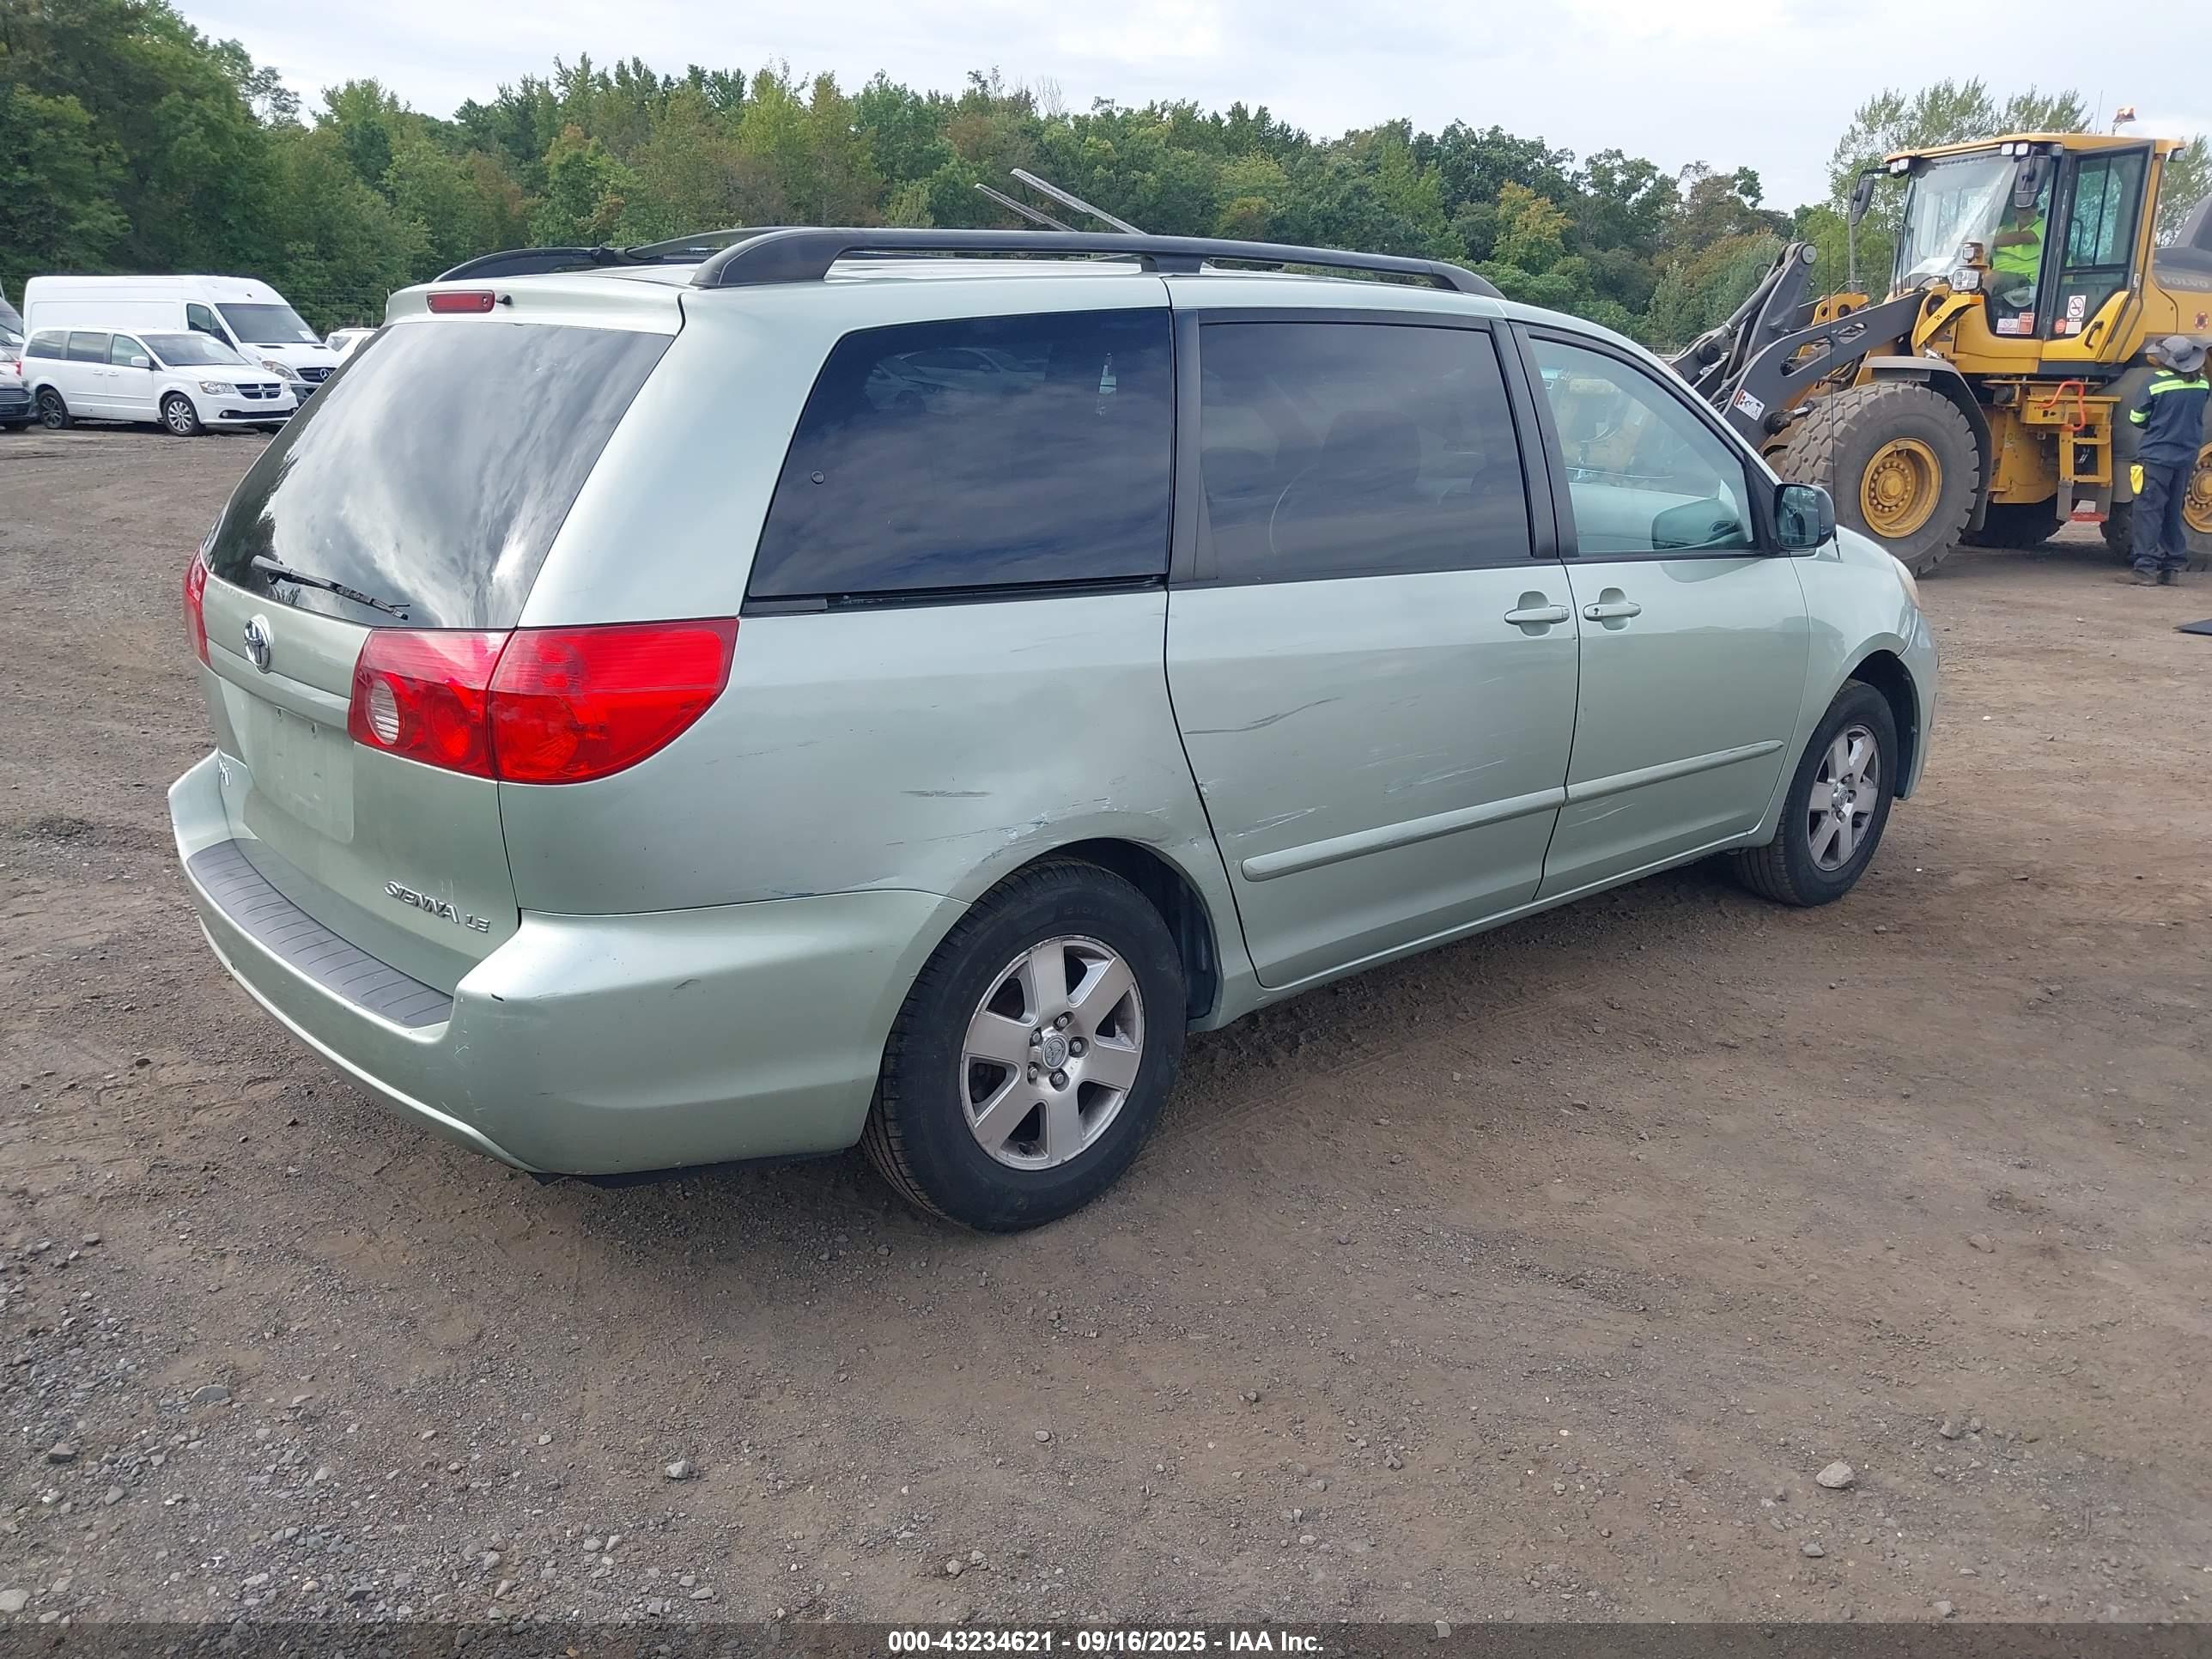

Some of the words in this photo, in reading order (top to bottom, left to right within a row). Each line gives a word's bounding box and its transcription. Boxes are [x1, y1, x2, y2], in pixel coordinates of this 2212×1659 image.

[2160, 276, 2209, 289] VOLVO
[385, 879, 460, 924] SIENNA
[465, 914, 491, 933] LE
